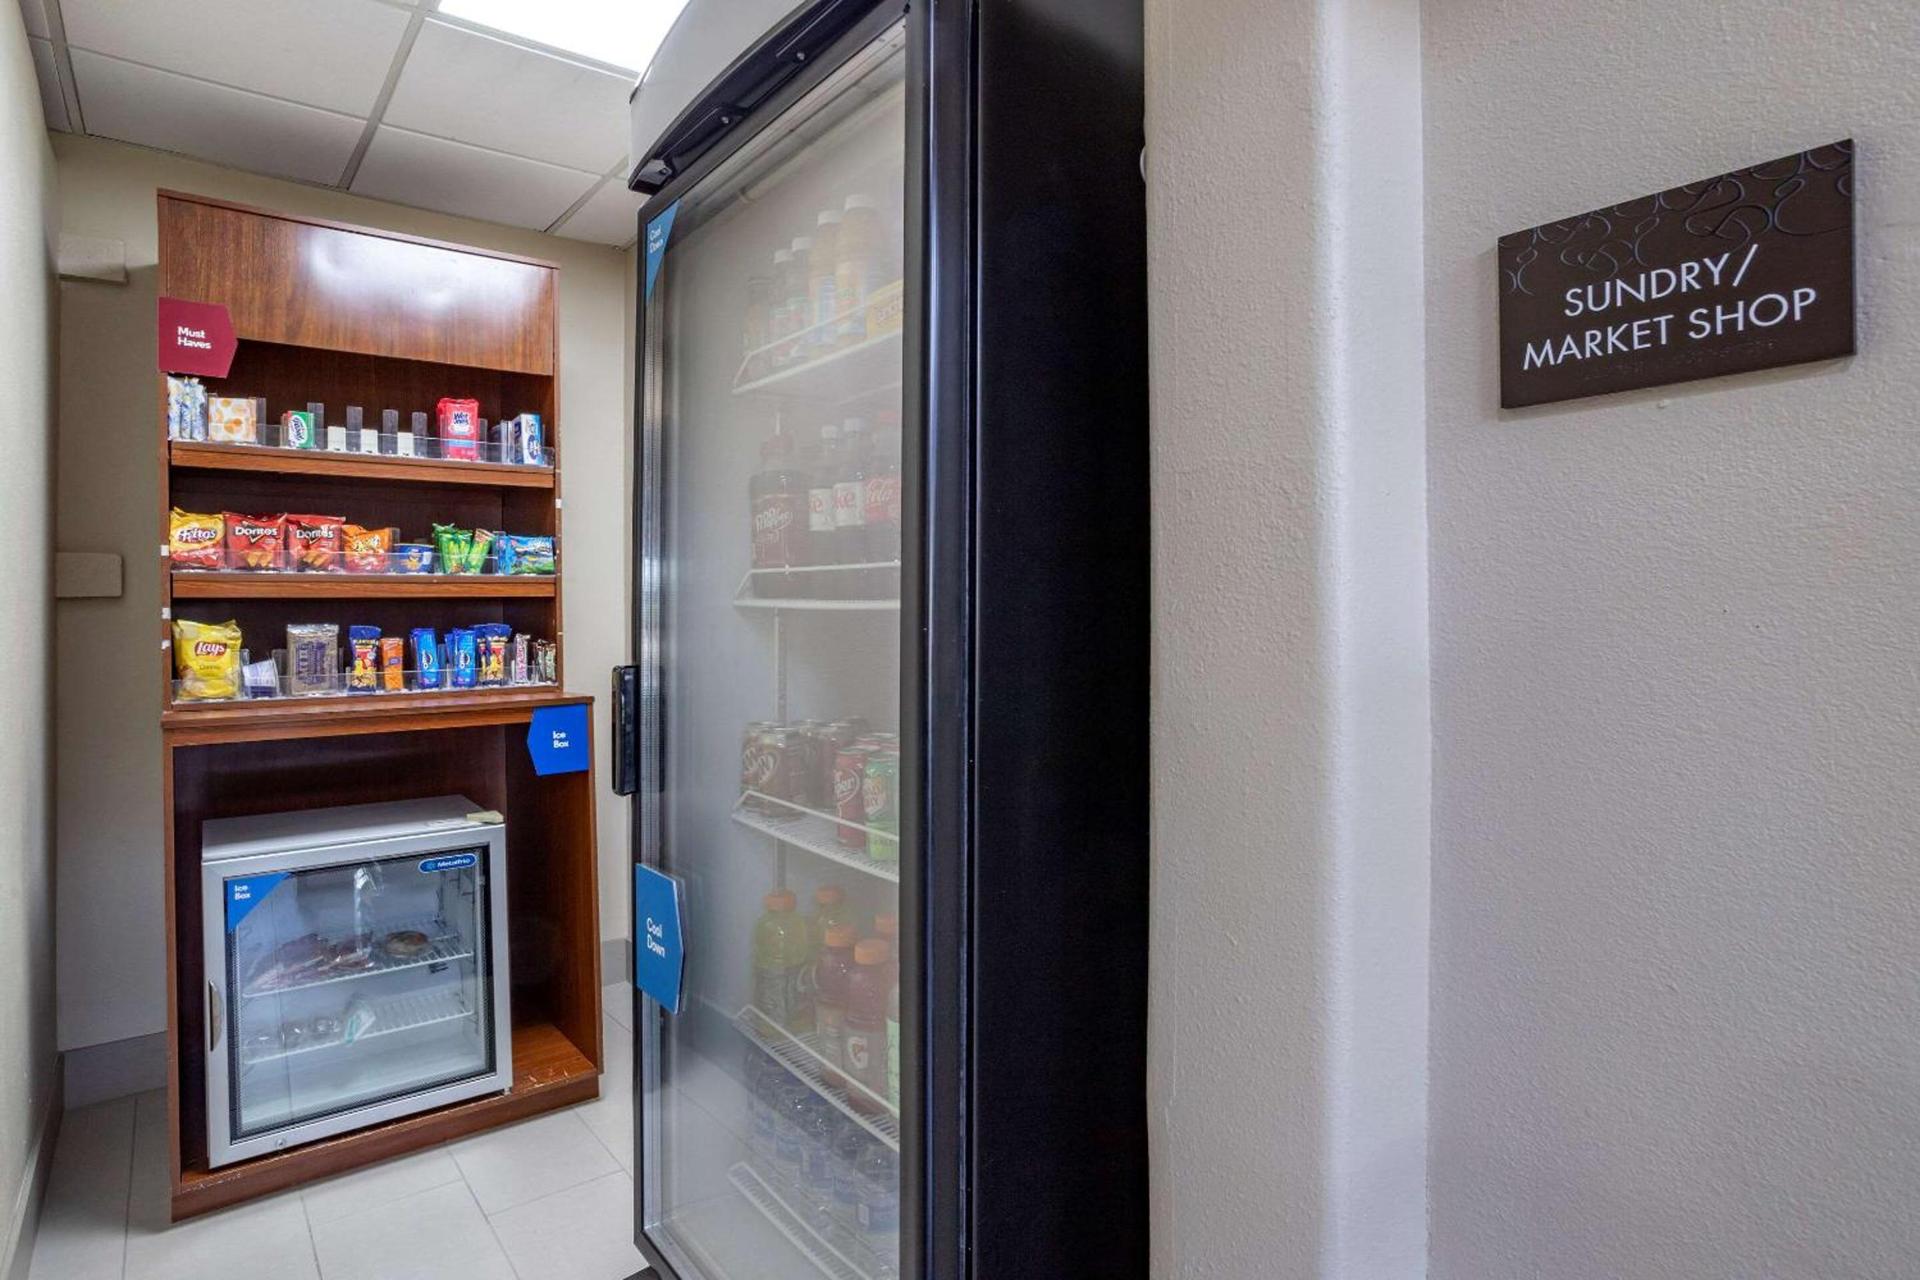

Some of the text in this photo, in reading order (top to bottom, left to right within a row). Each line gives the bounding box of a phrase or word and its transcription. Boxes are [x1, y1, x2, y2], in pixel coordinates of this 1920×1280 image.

[1564, 243, 1759, 317] SUNDRY/
[177, 326, 206, 339] Must
[1523, 287, 1817, 371] MARKET SHOP
[177, 336, 212, 349] Haves
[177, 528, 217, 543] Fritos
[234, 526, 278, 537] Doritos
[296, 526, 334, 539] Doritos
[552, 730, 567, 739] Ice
[553, 739, 569, 749] Box
[234, 892, 251, 900] Box
[646, 917, 663, 939] Cool
[646, 933, 666, 959] Down
